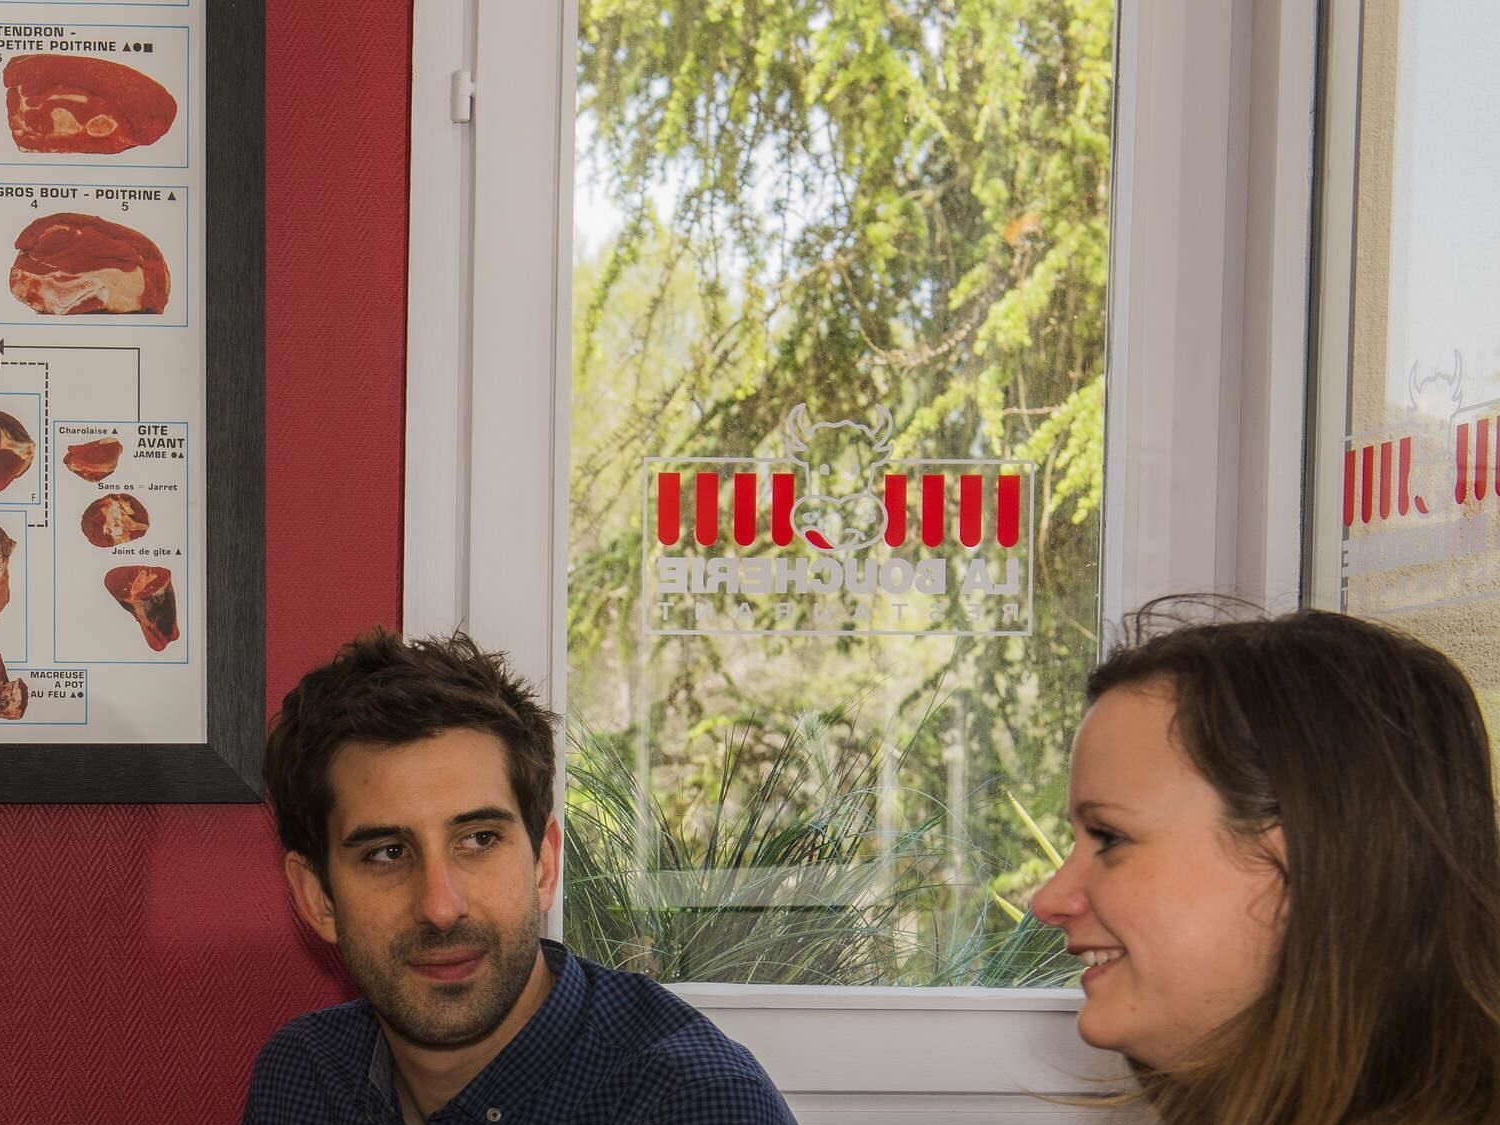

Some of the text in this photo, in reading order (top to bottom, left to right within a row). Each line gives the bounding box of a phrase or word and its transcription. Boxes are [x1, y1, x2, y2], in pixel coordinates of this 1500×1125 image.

[50, 41, 116, 52] POITRINE
[40, 188, 78, 198] BOUT
[95, 190, 161, 200] POITRINE
[31, 200, 38, 209] 4
[122, 202, 129, 211] 5
[59, 426, 108, 435] Charolaise
[137, 425, 168, 436] GITE
[137, 438, 185, 449] AVANT
[133, 451, 167, 459] JAMBE
[98, 482, 121, 491] Sans
[148, 483, 178, 491] Jarret
[112, 547, 135, 555] Joint
[30, 671, 85, 679] MACREUSE
[64, 681, 84, 689] POT
[48, 690, 66, 698] FEU
